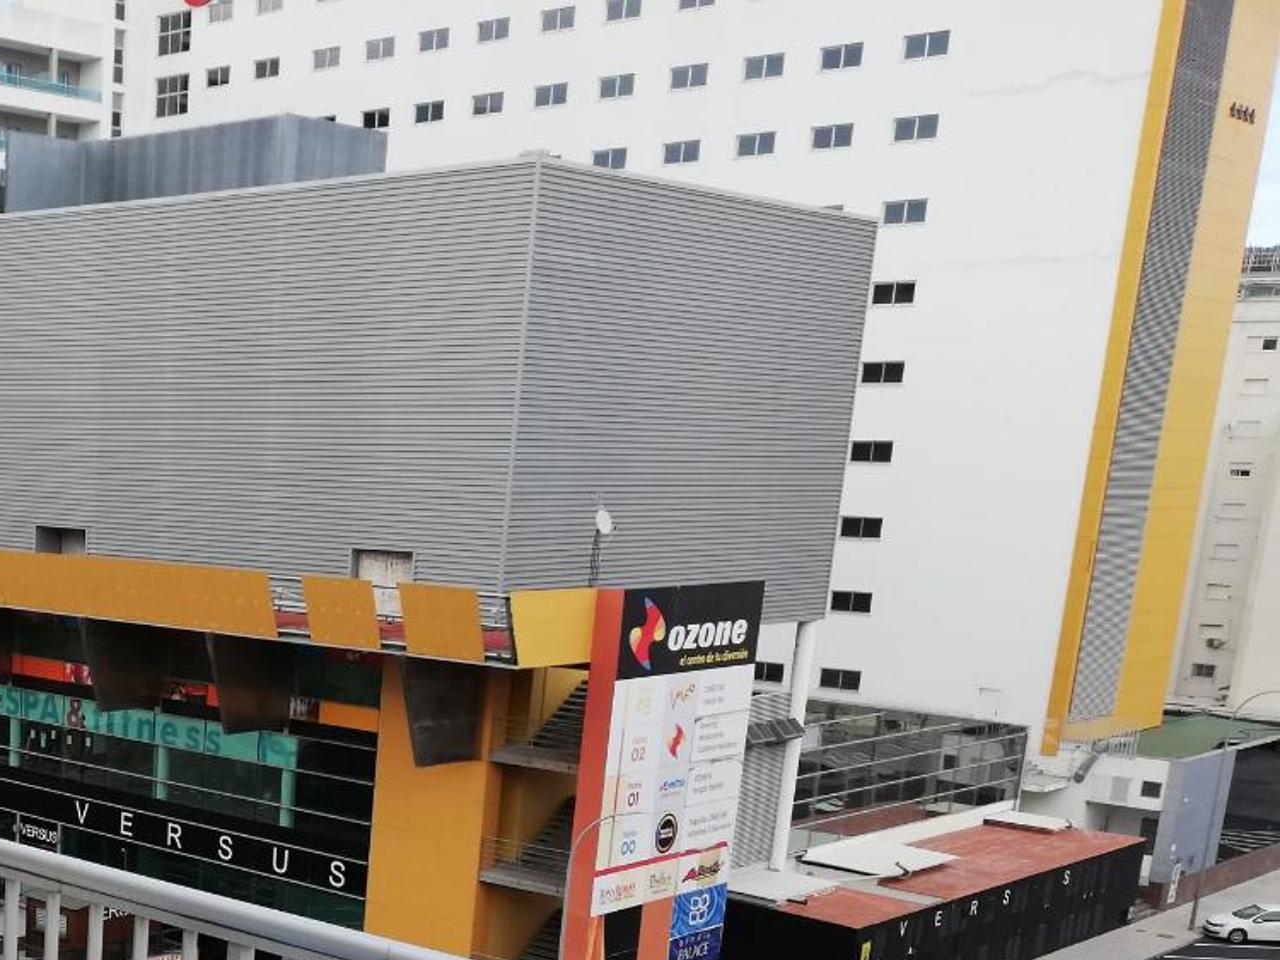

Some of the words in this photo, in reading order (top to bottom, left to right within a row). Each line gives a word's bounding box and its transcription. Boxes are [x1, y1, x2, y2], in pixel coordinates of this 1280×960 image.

[667, 619, 748, 651] ozone
[7, 686, 60, 724] SPA
[20, 822, 58, 843] VERSUS
[75, 800, 346, 888] VERSUS
